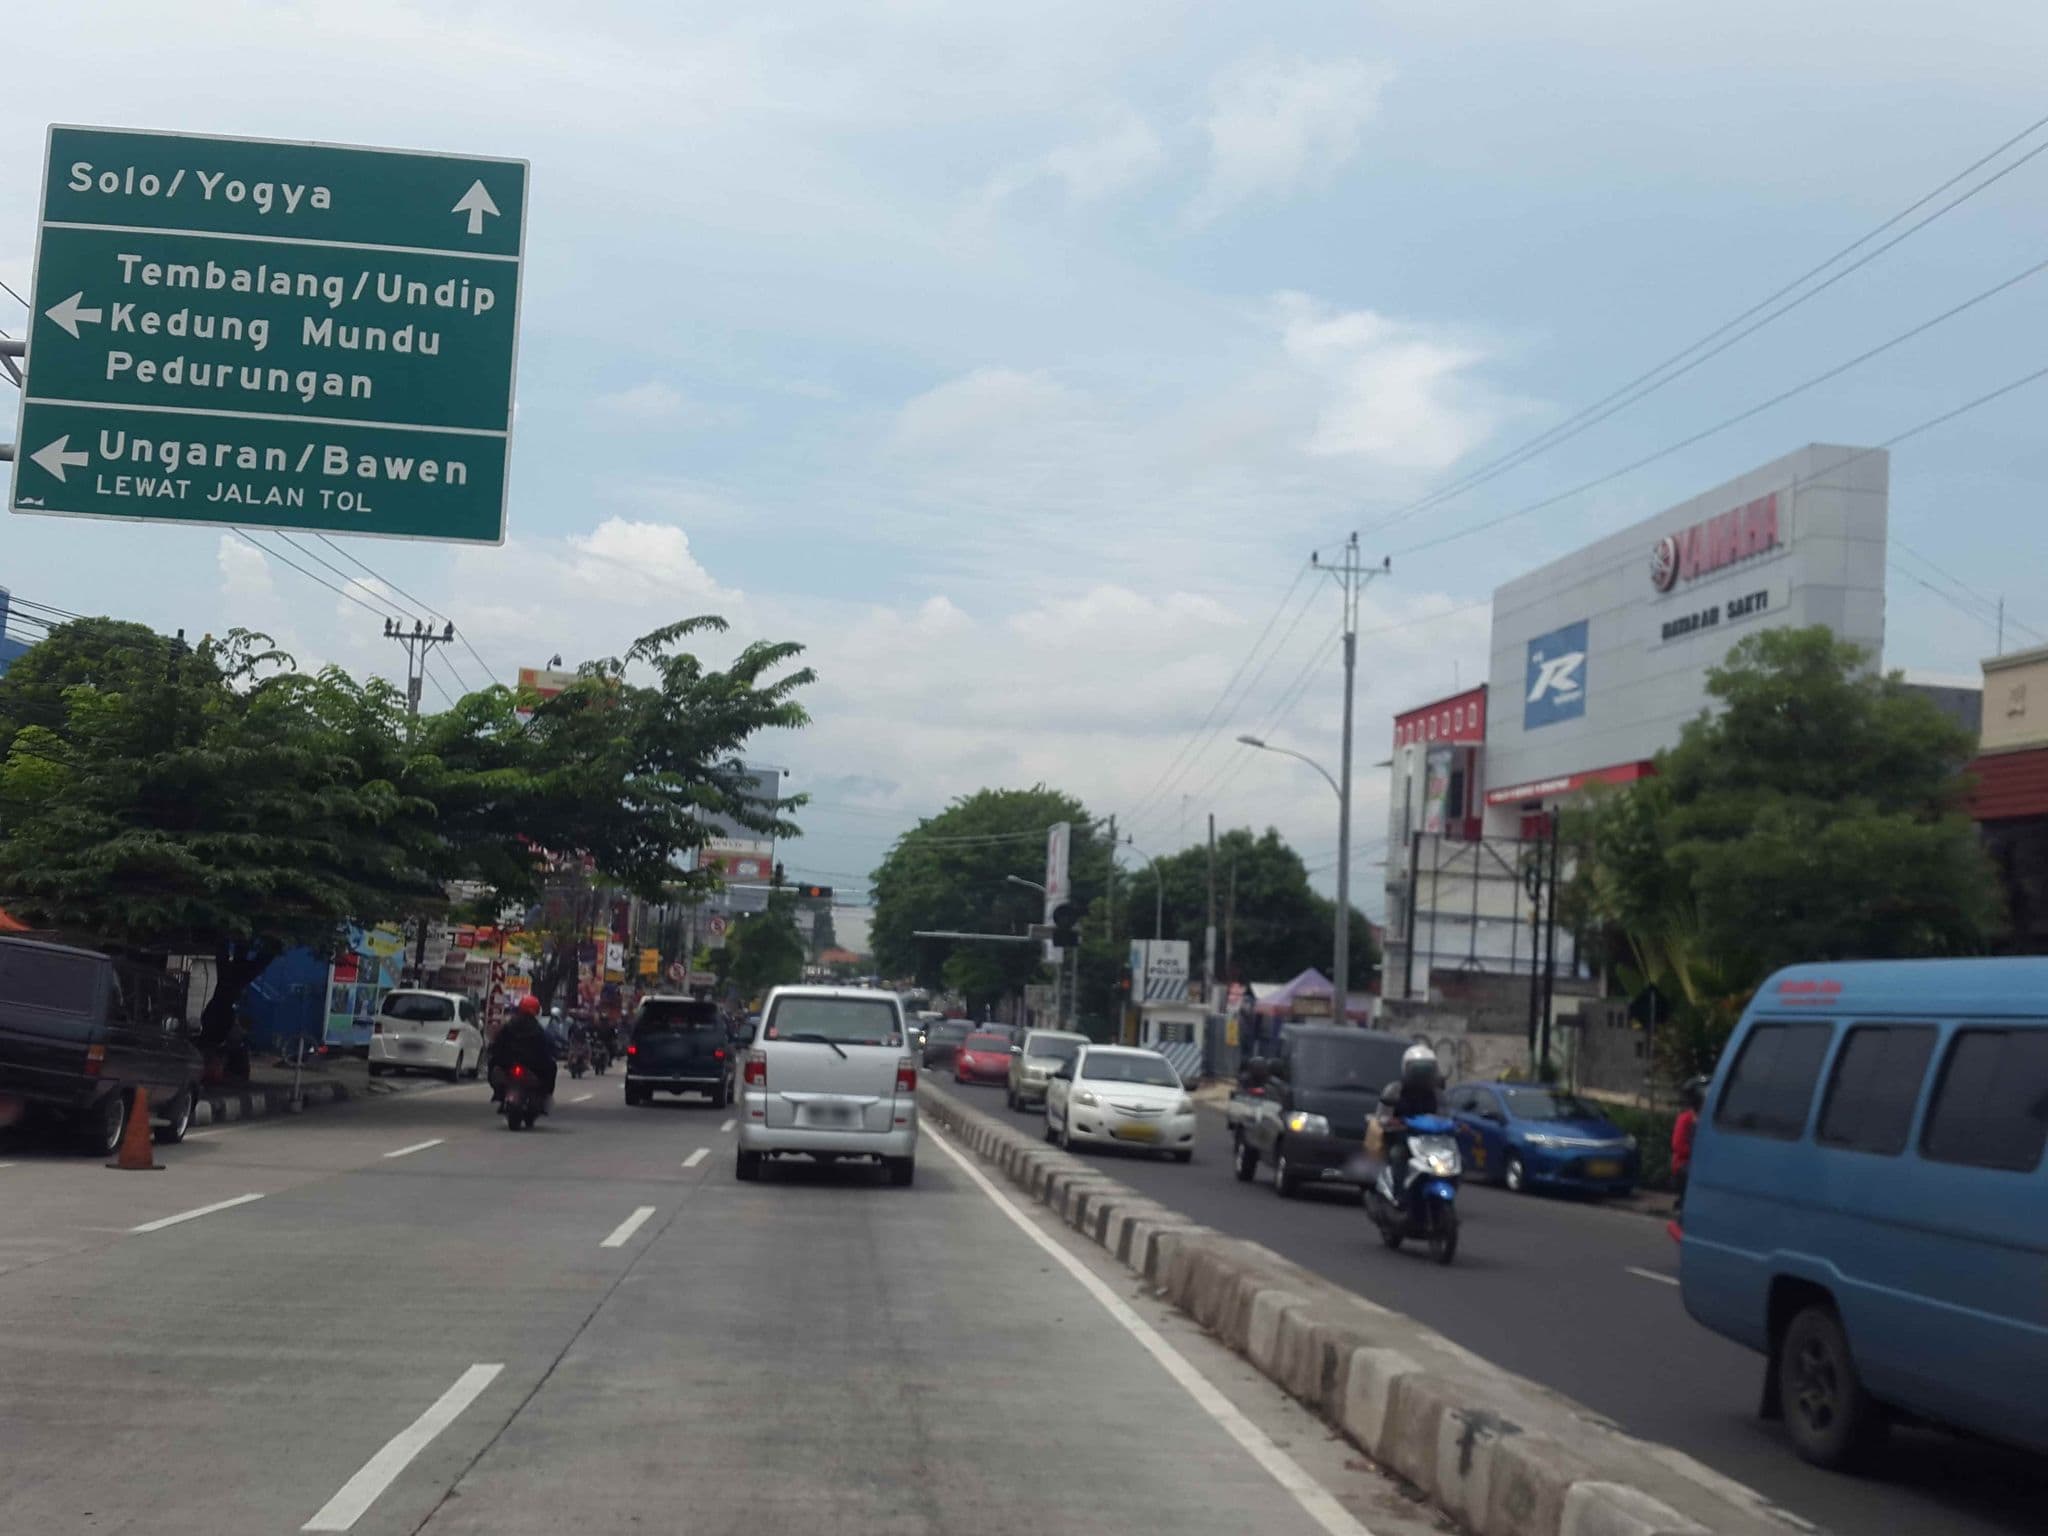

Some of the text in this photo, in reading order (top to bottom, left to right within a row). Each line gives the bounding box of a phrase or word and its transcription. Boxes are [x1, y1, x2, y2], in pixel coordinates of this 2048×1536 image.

[69, 161, 332, 214] Solo/Yogya
[118, 253, 496, 315] Tembalang/Undip
[111, 303, 440, 355] Kedung Mundu
[107, 351, 372, 402] Pedurungan
[100, 430, 468, 485] Ungaran/Bawen
[96, 475, 372, 512] LEWAT JALAN TOL
[1674, 492, 1778, 579] YAMAHA
